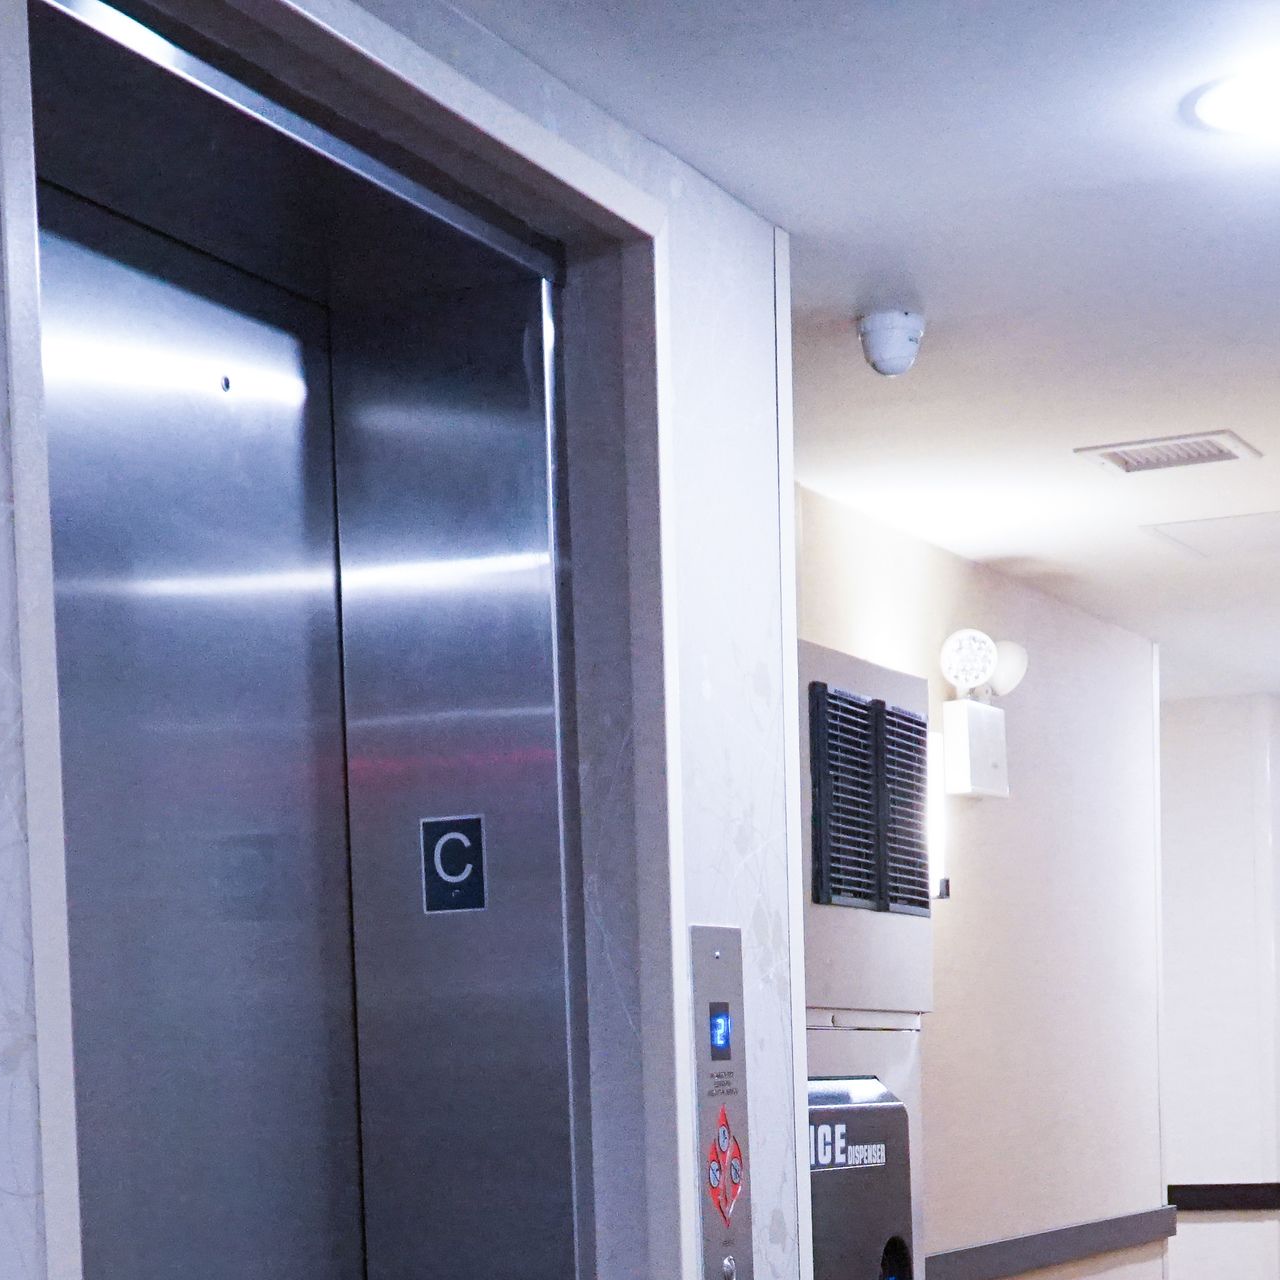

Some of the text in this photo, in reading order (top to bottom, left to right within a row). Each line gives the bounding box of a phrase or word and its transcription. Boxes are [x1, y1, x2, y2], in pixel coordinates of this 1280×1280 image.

[434, 832, 473, 883] C
[715, 1018, 726, 1045] 2
[810, 1124, 886, 1165] ICE DISPENSER
